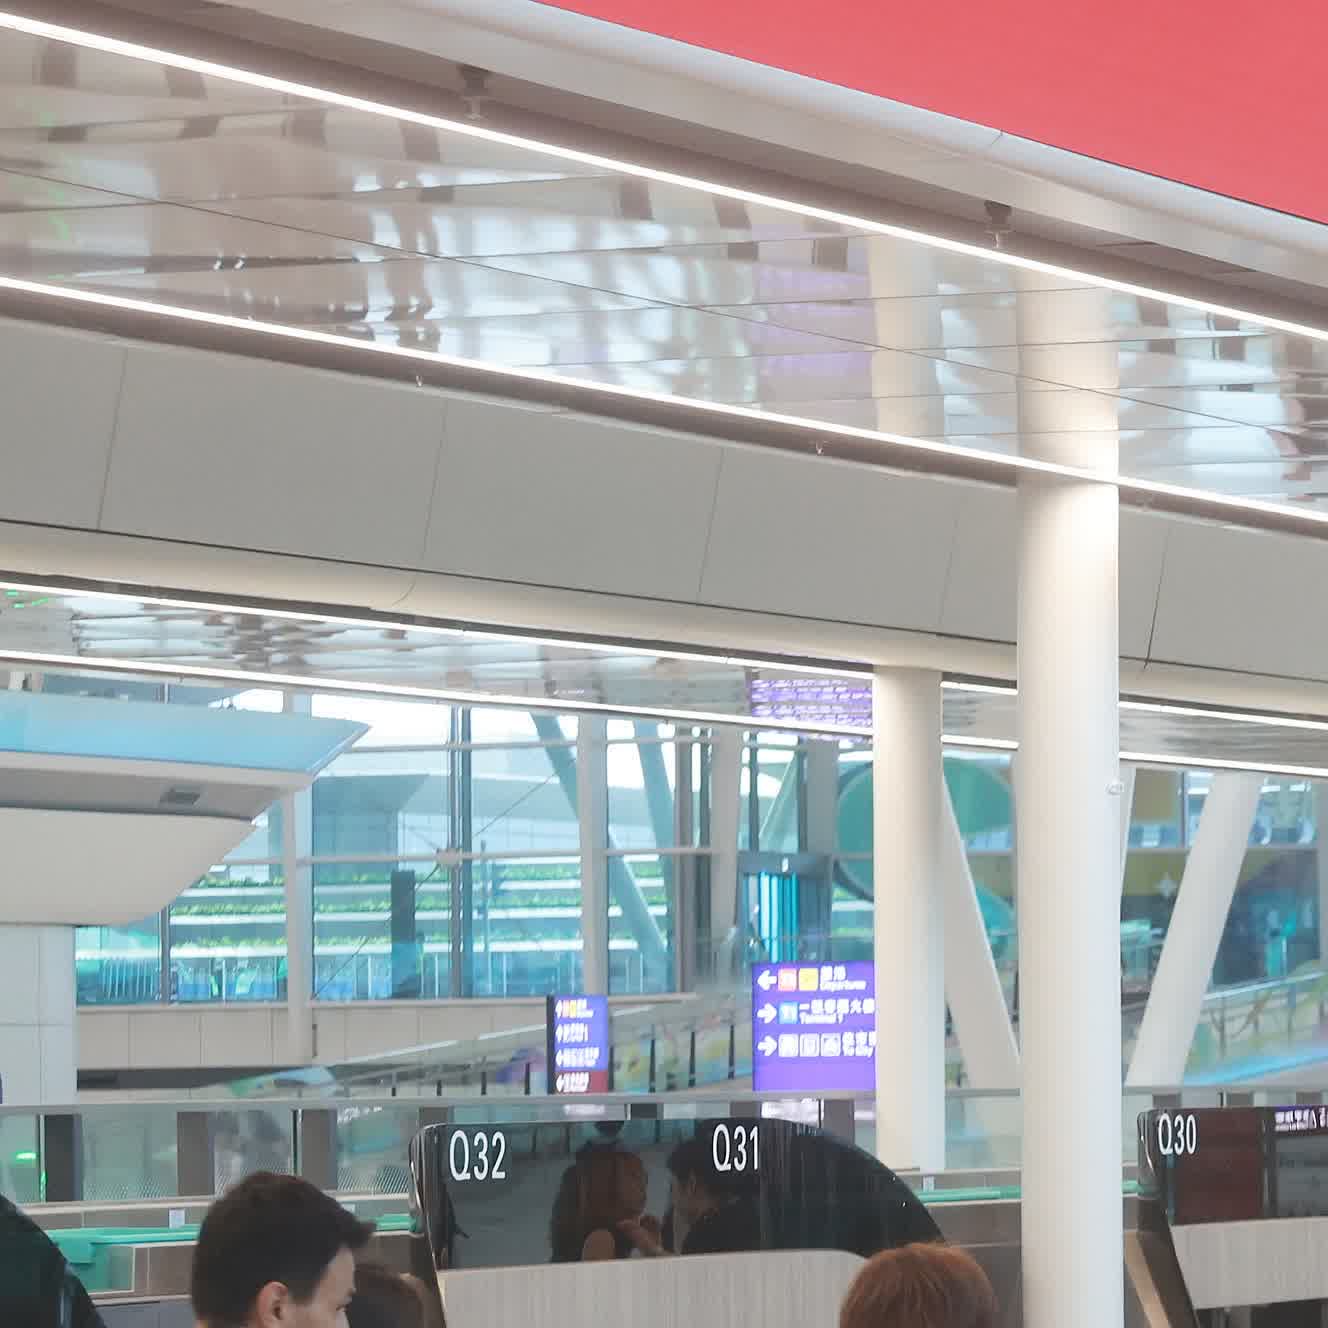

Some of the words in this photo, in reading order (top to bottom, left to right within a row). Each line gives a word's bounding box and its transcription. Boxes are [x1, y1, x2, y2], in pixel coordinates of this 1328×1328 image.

[449, 1130, 506, 1181] Q32
[713, 1124, 759, 1172] Q31
[1158, 1113, 1196, 1155] Q30
